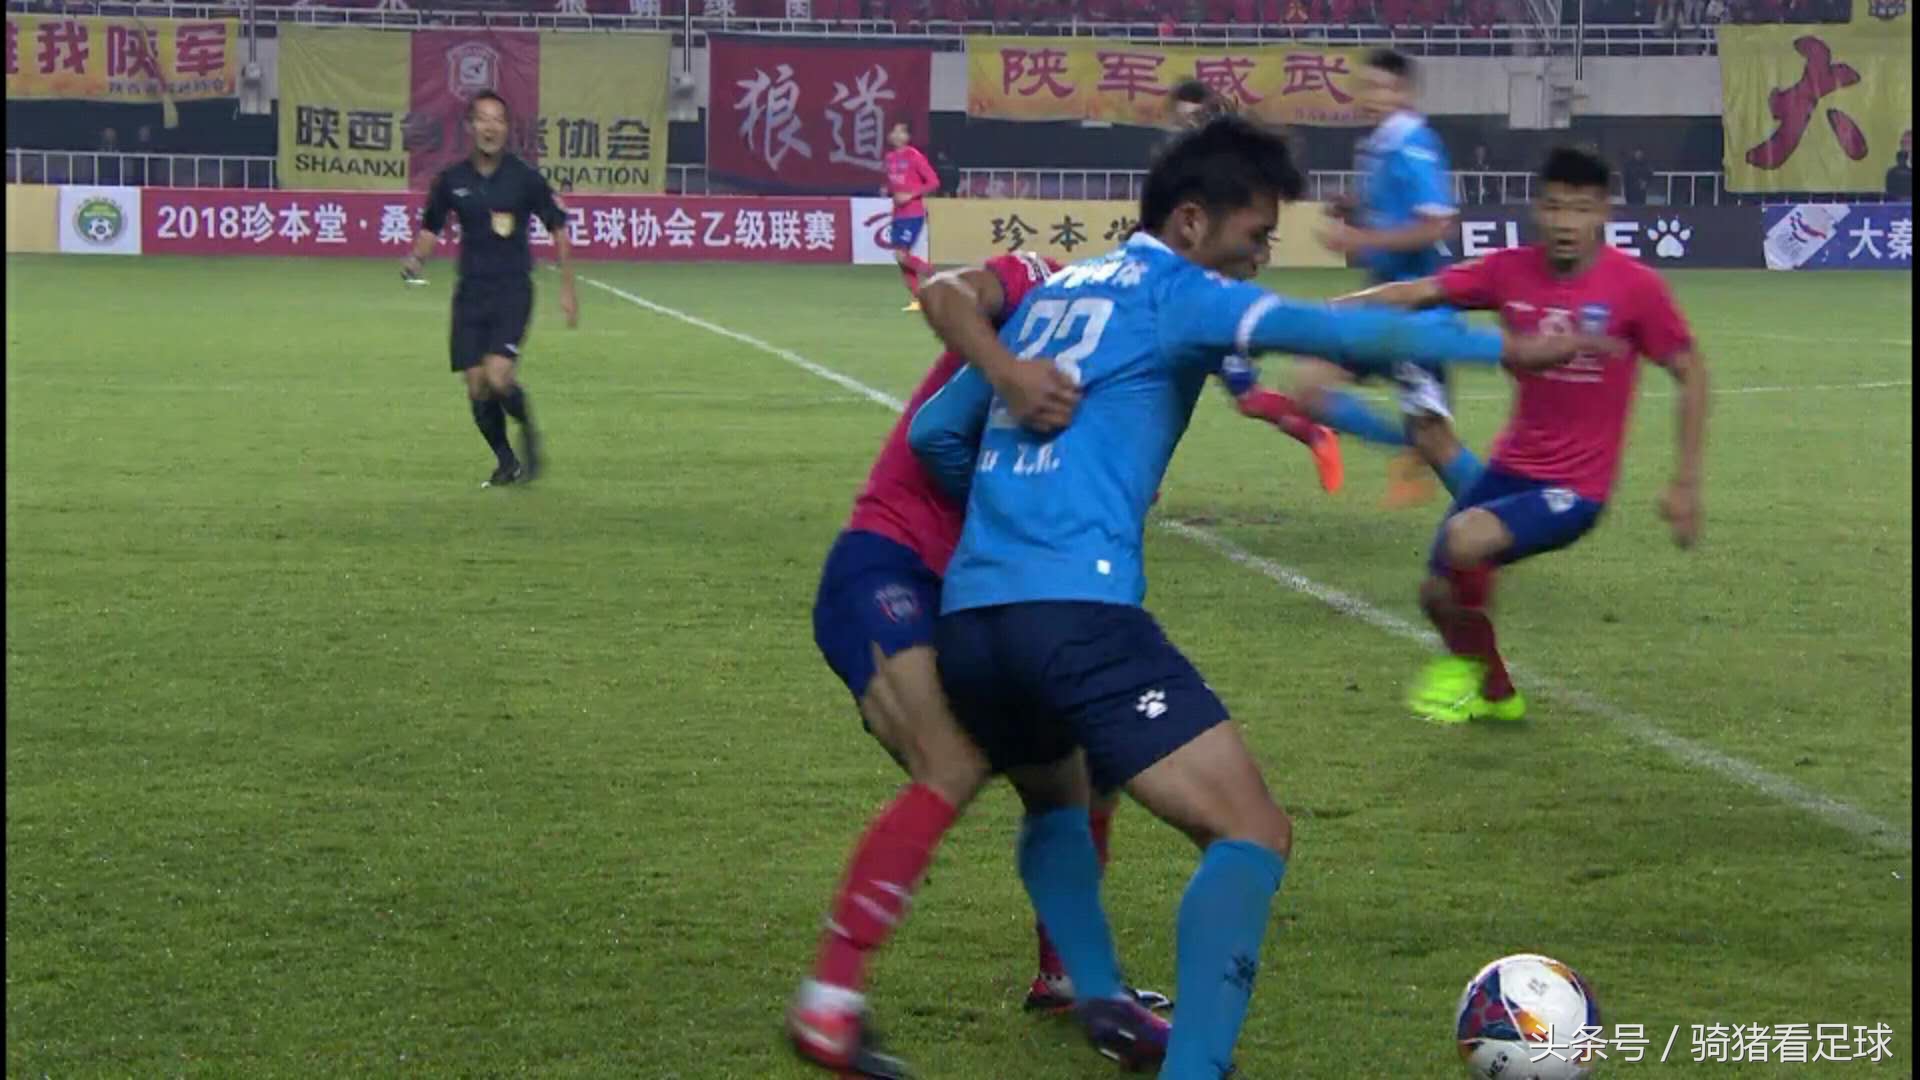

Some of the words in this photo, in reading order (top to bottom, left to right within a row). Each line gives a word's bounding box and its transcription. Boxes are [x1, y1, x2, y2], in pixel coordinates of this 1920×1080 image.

[732, 61, 896, 174] 狼道
[1001, 47, 1354, 105] 陕军威武
[1745, 35, 1869, 170] 大
[295, 154, 405, 178] SHAANXI
